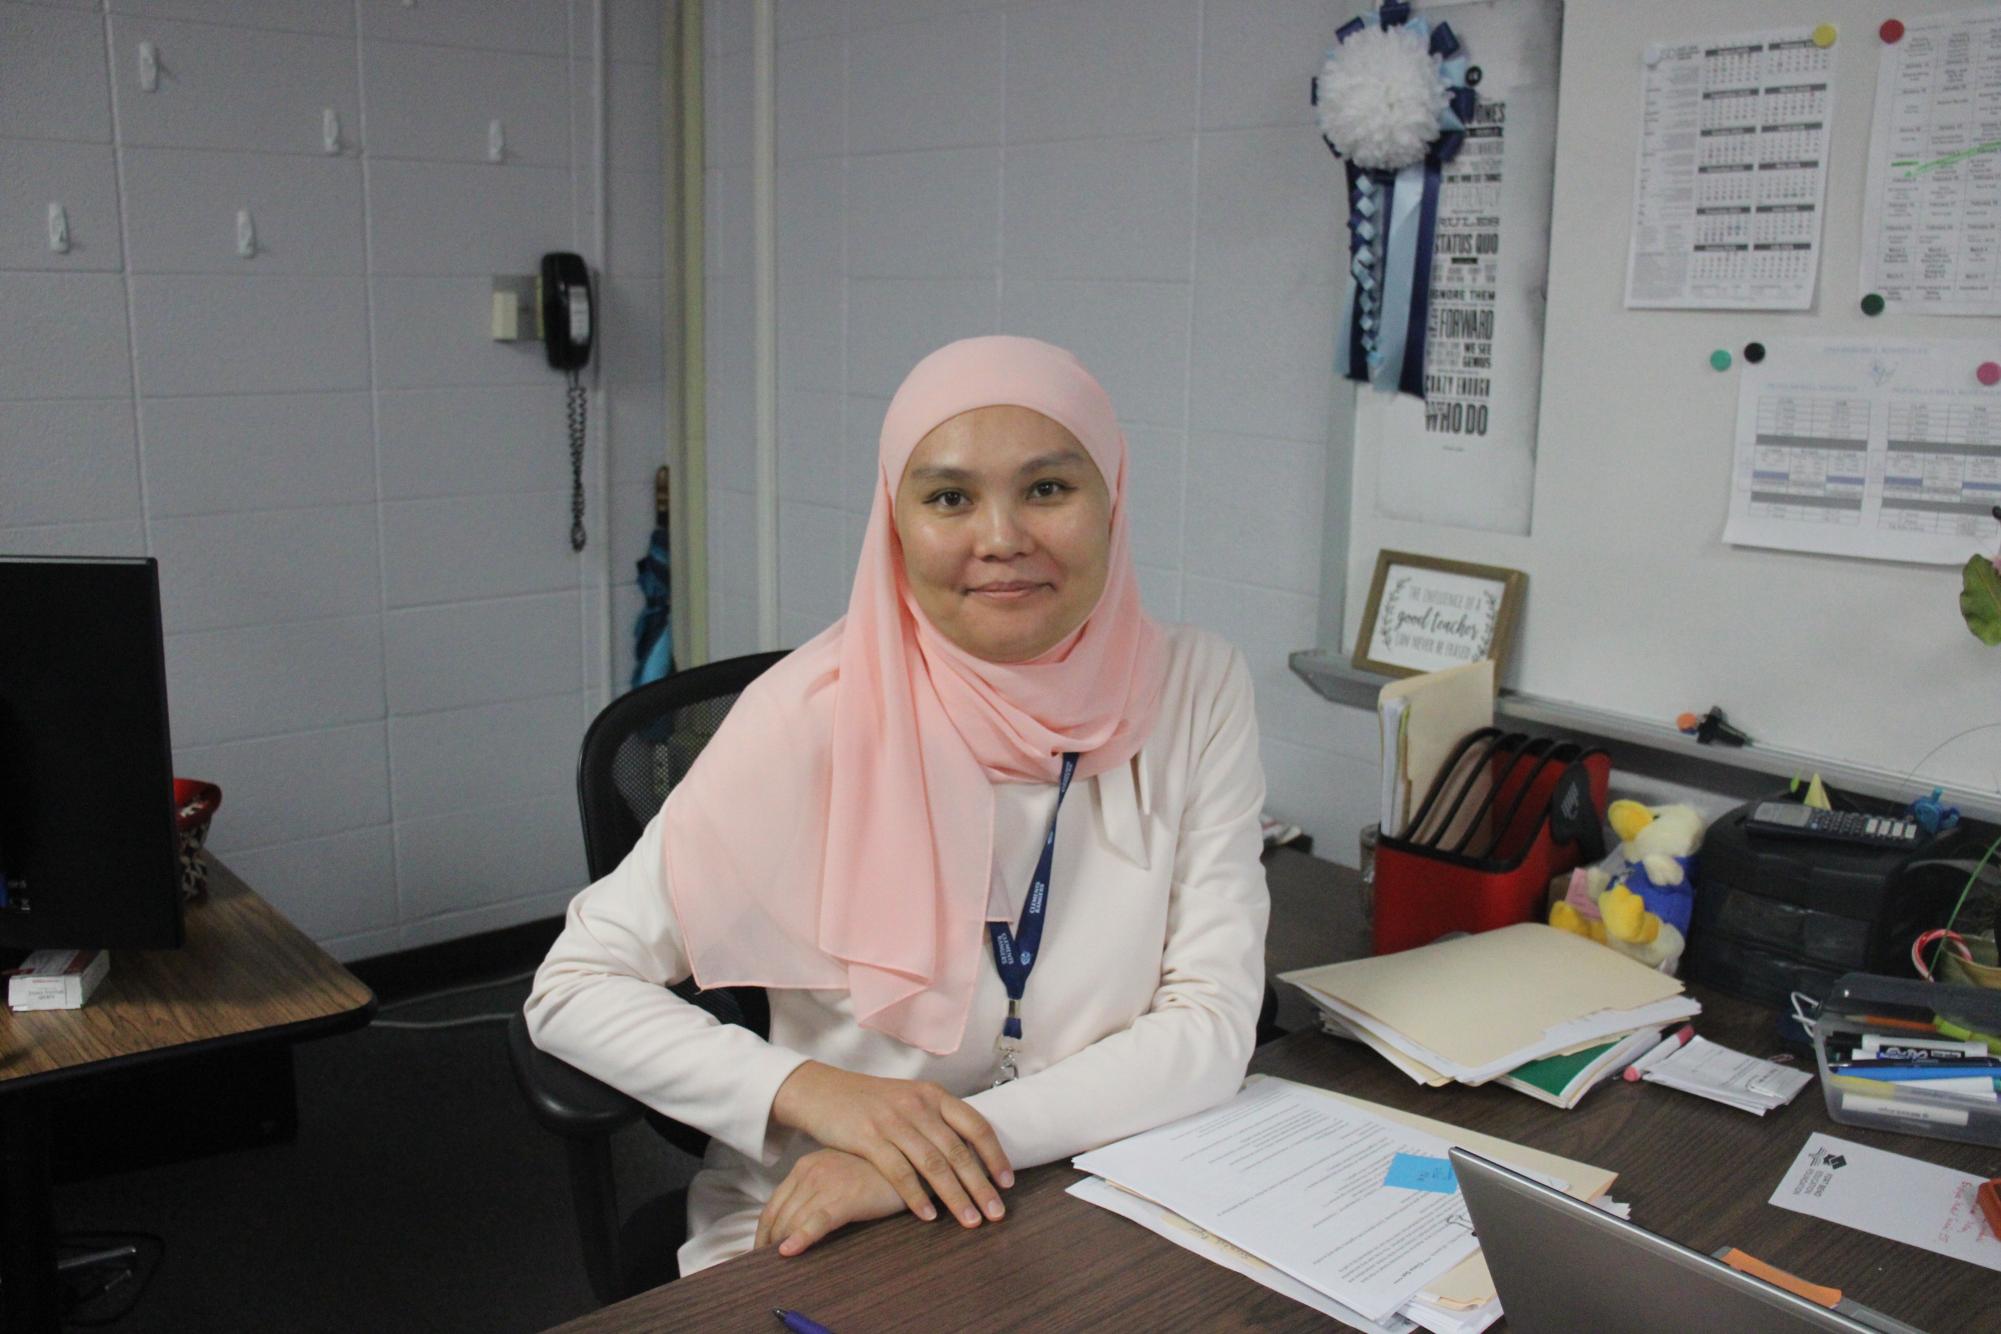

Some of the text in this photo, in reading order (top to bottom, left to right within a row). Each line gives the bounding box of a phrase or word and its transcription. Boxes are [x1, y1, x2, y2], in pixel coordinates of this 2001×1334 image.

[1434, 233, 1499, 255] STATUS QUO
[1440, 308, 1495, 340] FORWARD
[1425, 402, 1489, 436] WHO DO
[1394, 606, 1478, 640] good teacher
[1029, 881, 1041, 914] CLEMENTS
[1034, 883, 1045, 914] RANGERS
[997, 935, 1008, 965] RANGERS
[1001, 932, 1014, 965] CLEMENTS
